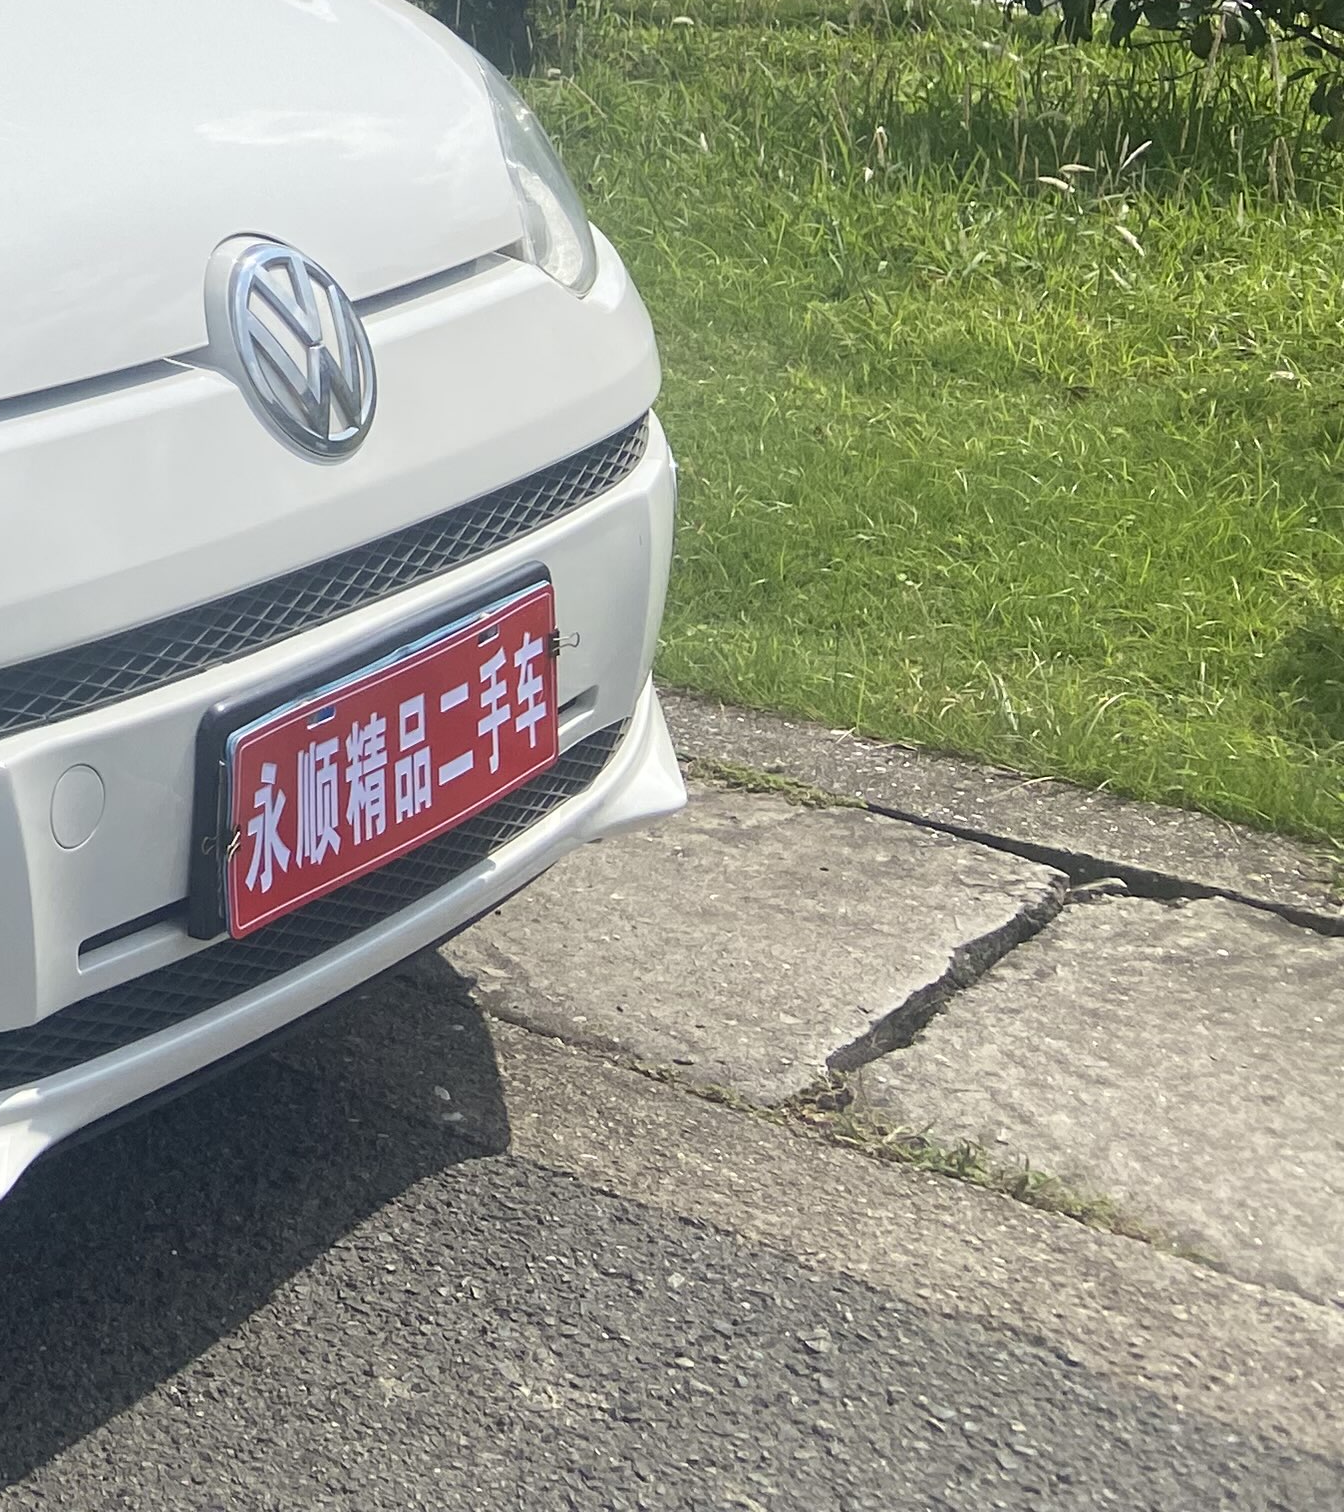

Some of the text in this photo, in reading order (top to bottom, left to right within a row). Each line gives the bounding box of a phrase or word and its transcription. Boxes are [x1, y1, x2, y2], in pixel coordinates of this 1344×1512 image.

[245, 632, 547, 893] 永顺精品二手车
